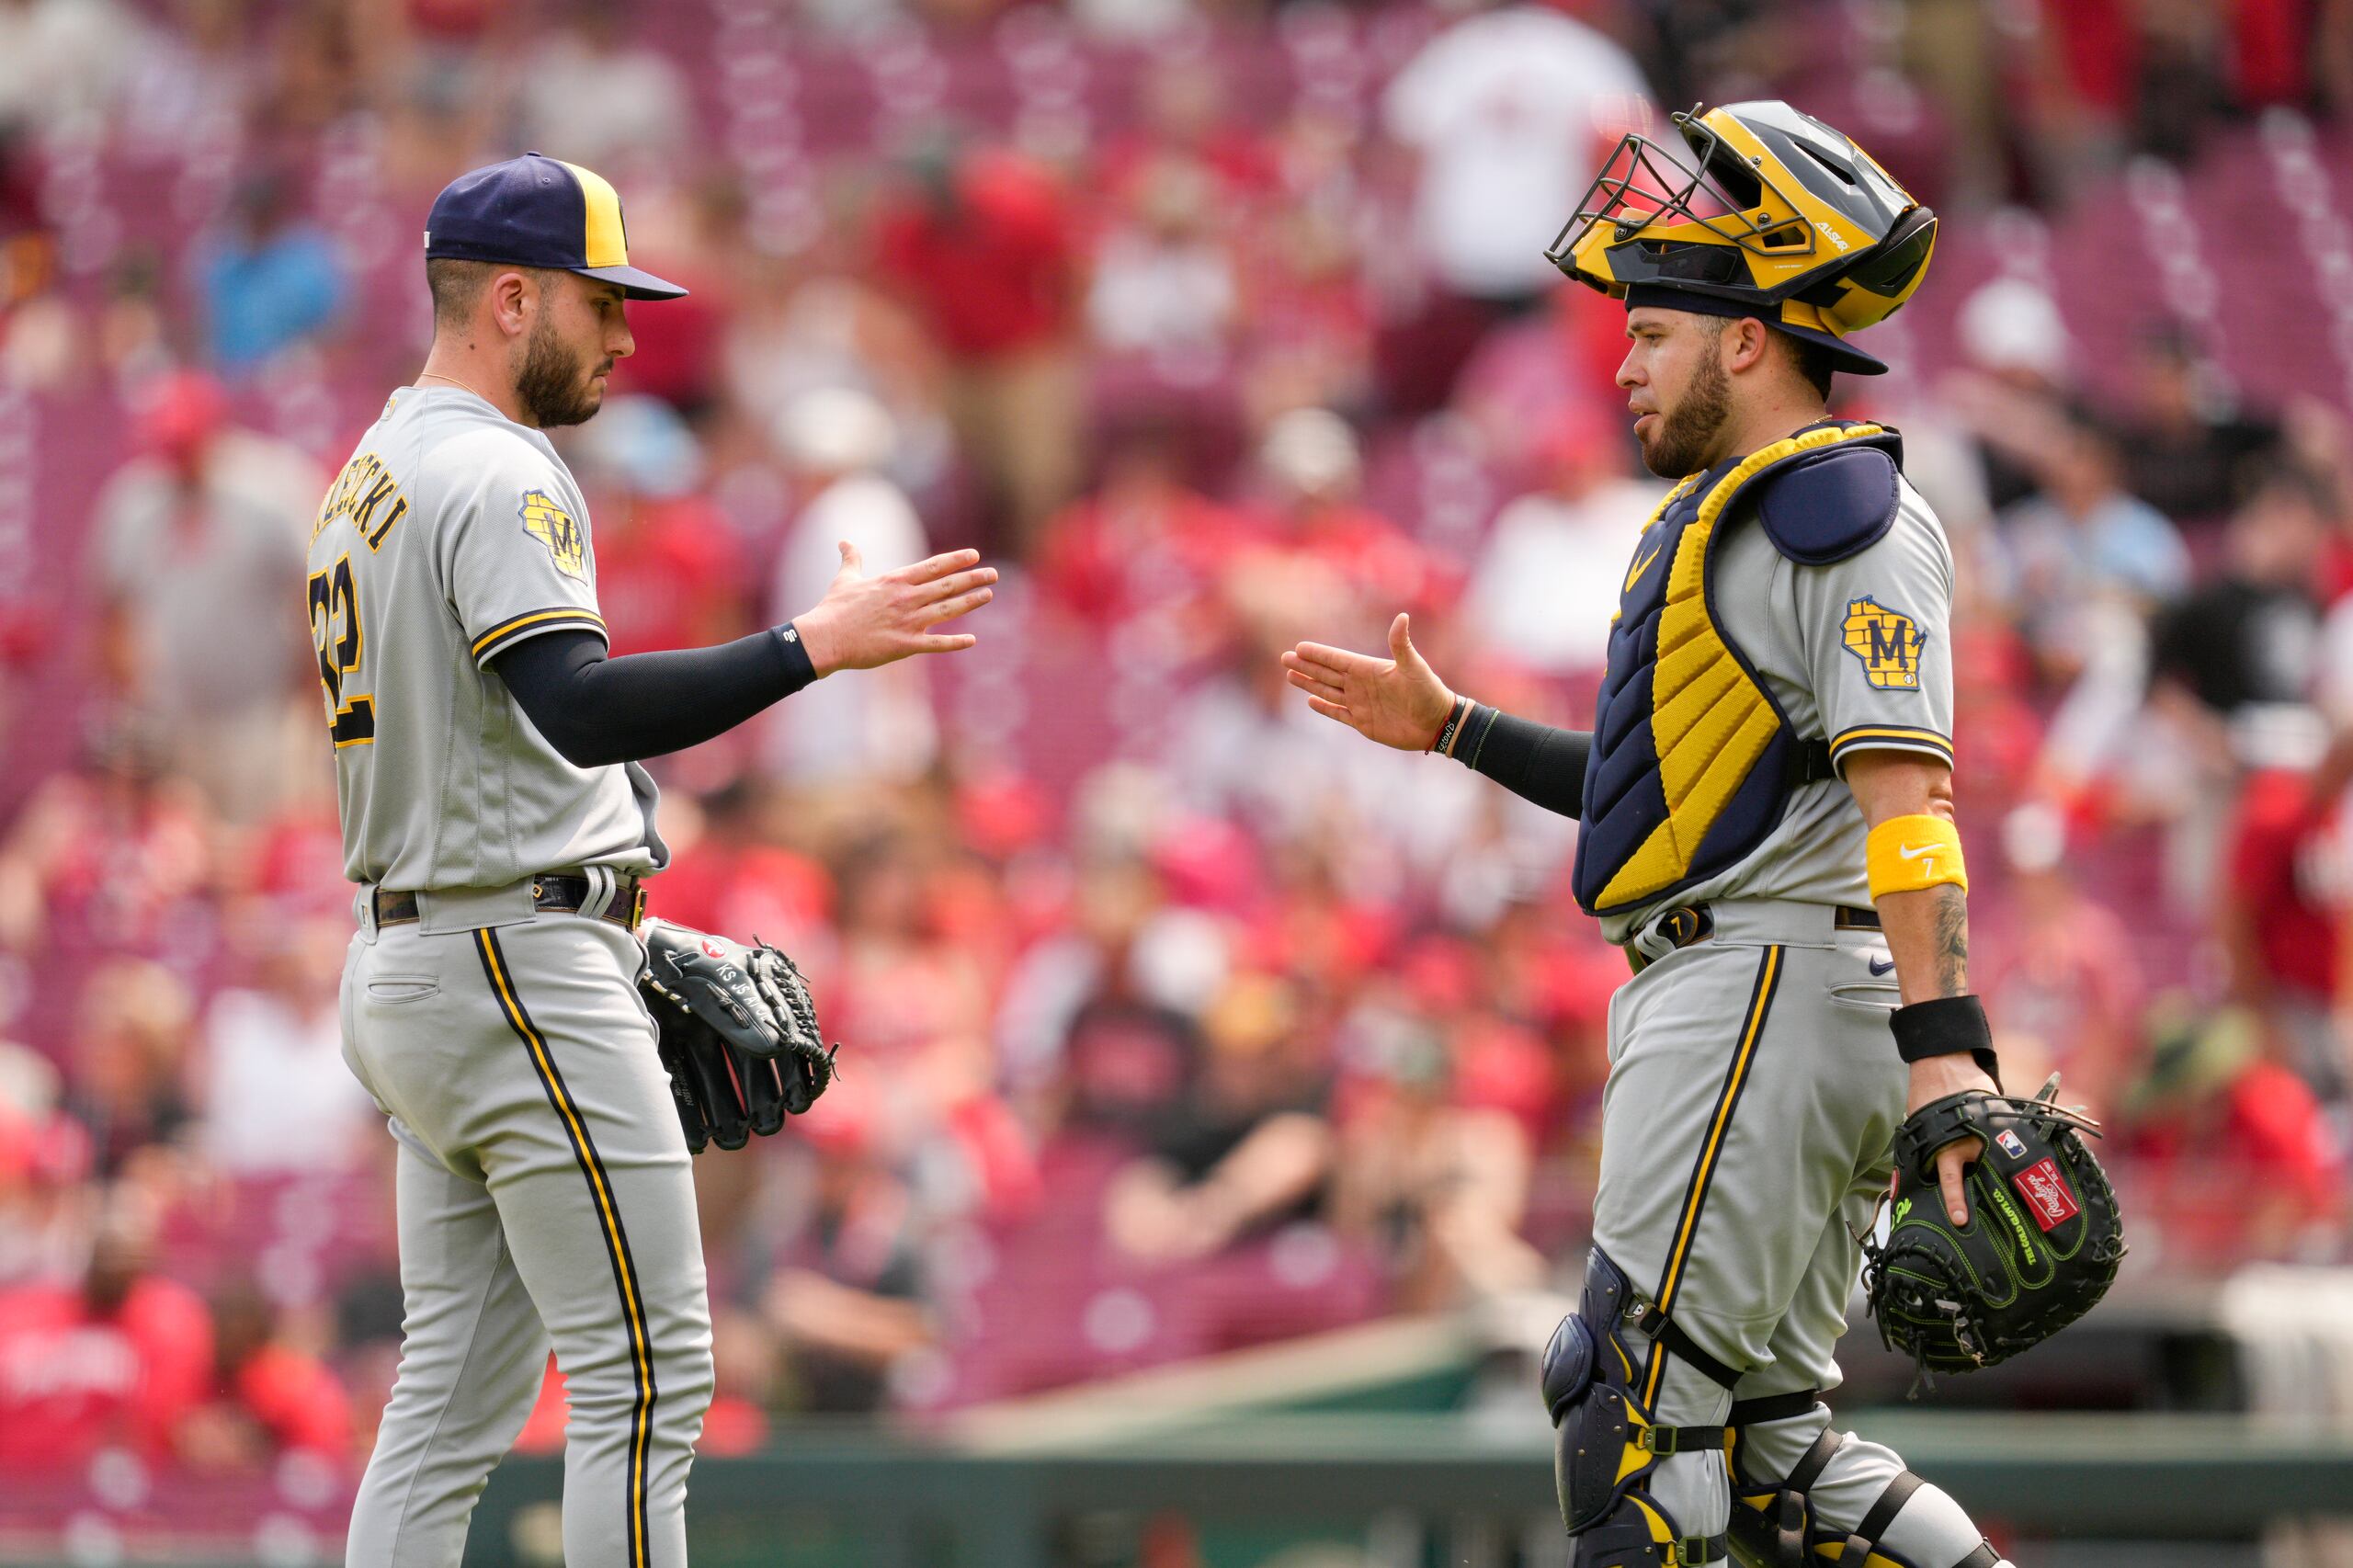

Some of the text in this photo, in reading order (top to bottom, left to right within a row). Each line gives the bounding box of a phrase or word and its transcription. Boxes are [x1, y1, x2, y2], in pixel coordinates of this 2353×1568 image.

[1867, 619, 1909, 668] M
[1922, 857, 1934, 879] 7
[1670, 915, 1682, 937] 7
[715, 962, 737, 982] KS
[731, 983, 751, 994] JS
[2027, 1174, 2065, 1217] Rawlings
[2000, 1199, 2020, 1226] GLOVE
[2015, 1224, 2030, 1248] GOLD
[2024, 1245, 2037, 1266] THE
